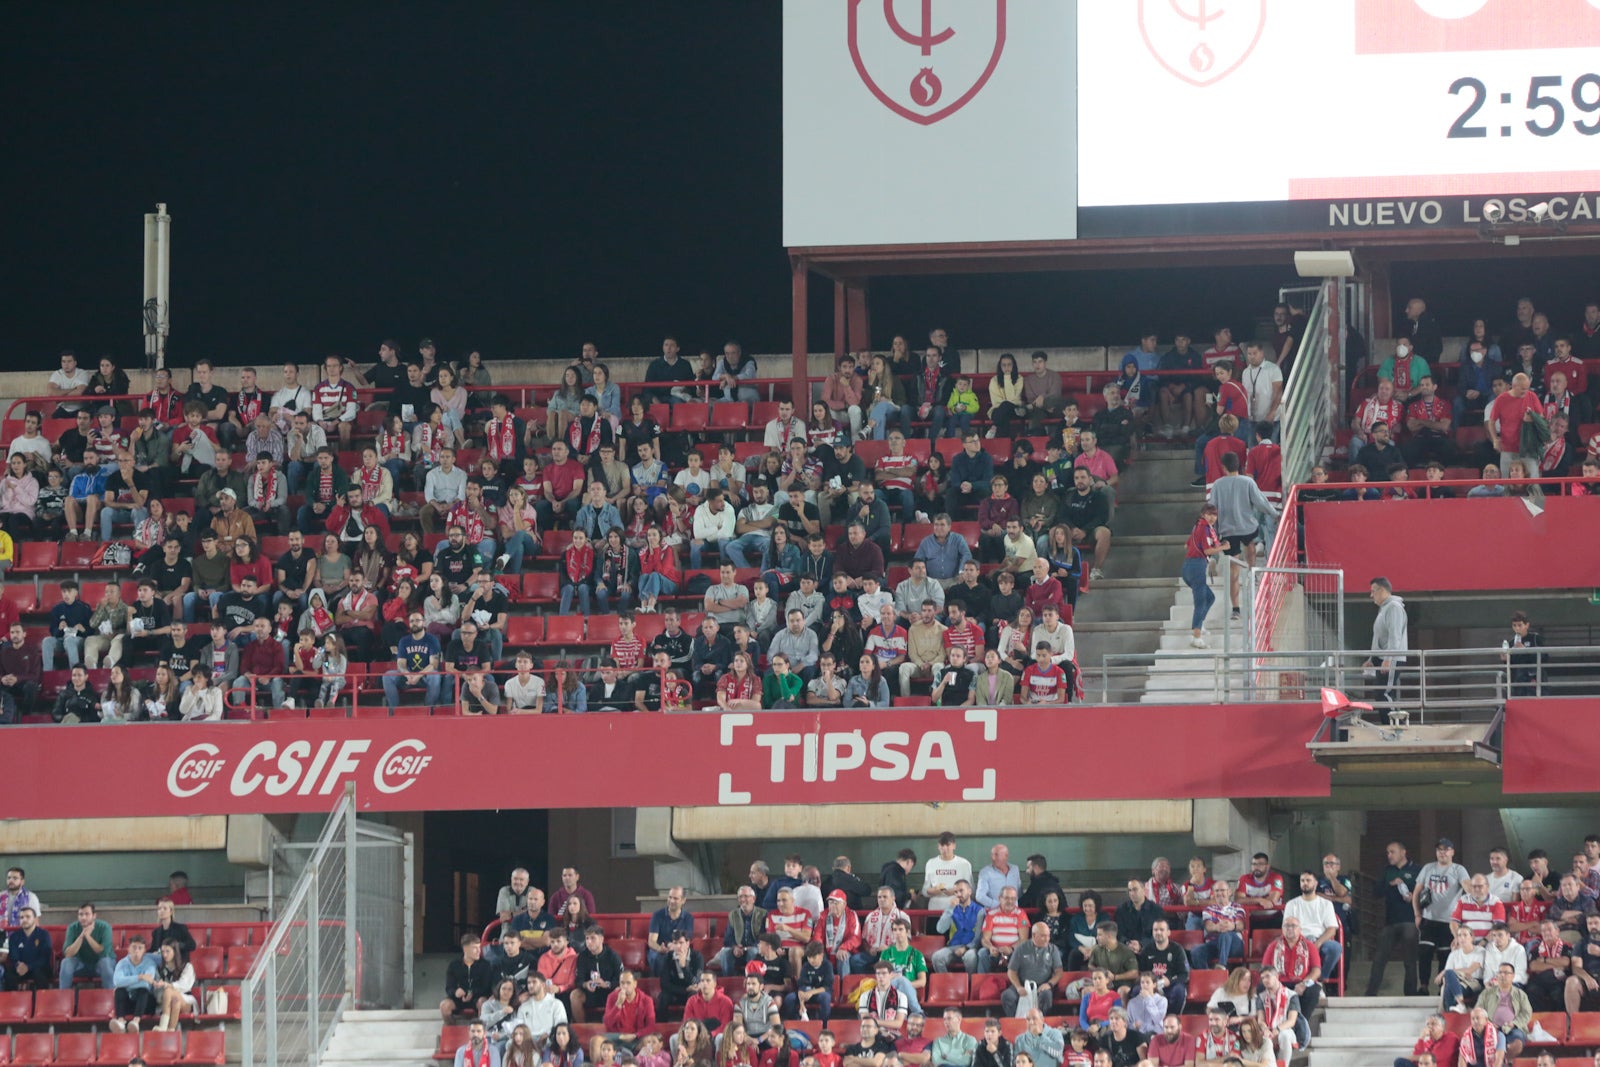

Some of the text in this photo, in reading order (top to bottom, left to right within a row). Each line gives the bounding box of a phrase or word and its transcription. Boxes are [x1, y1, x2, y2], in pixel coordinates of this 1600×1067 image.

[1329, 193, 1600, 226] NUEVO LOS CÁ
[178, 739, 433, 797] CSIF CSIF CSIF
[756, 730, 960, 783] TIPSA
